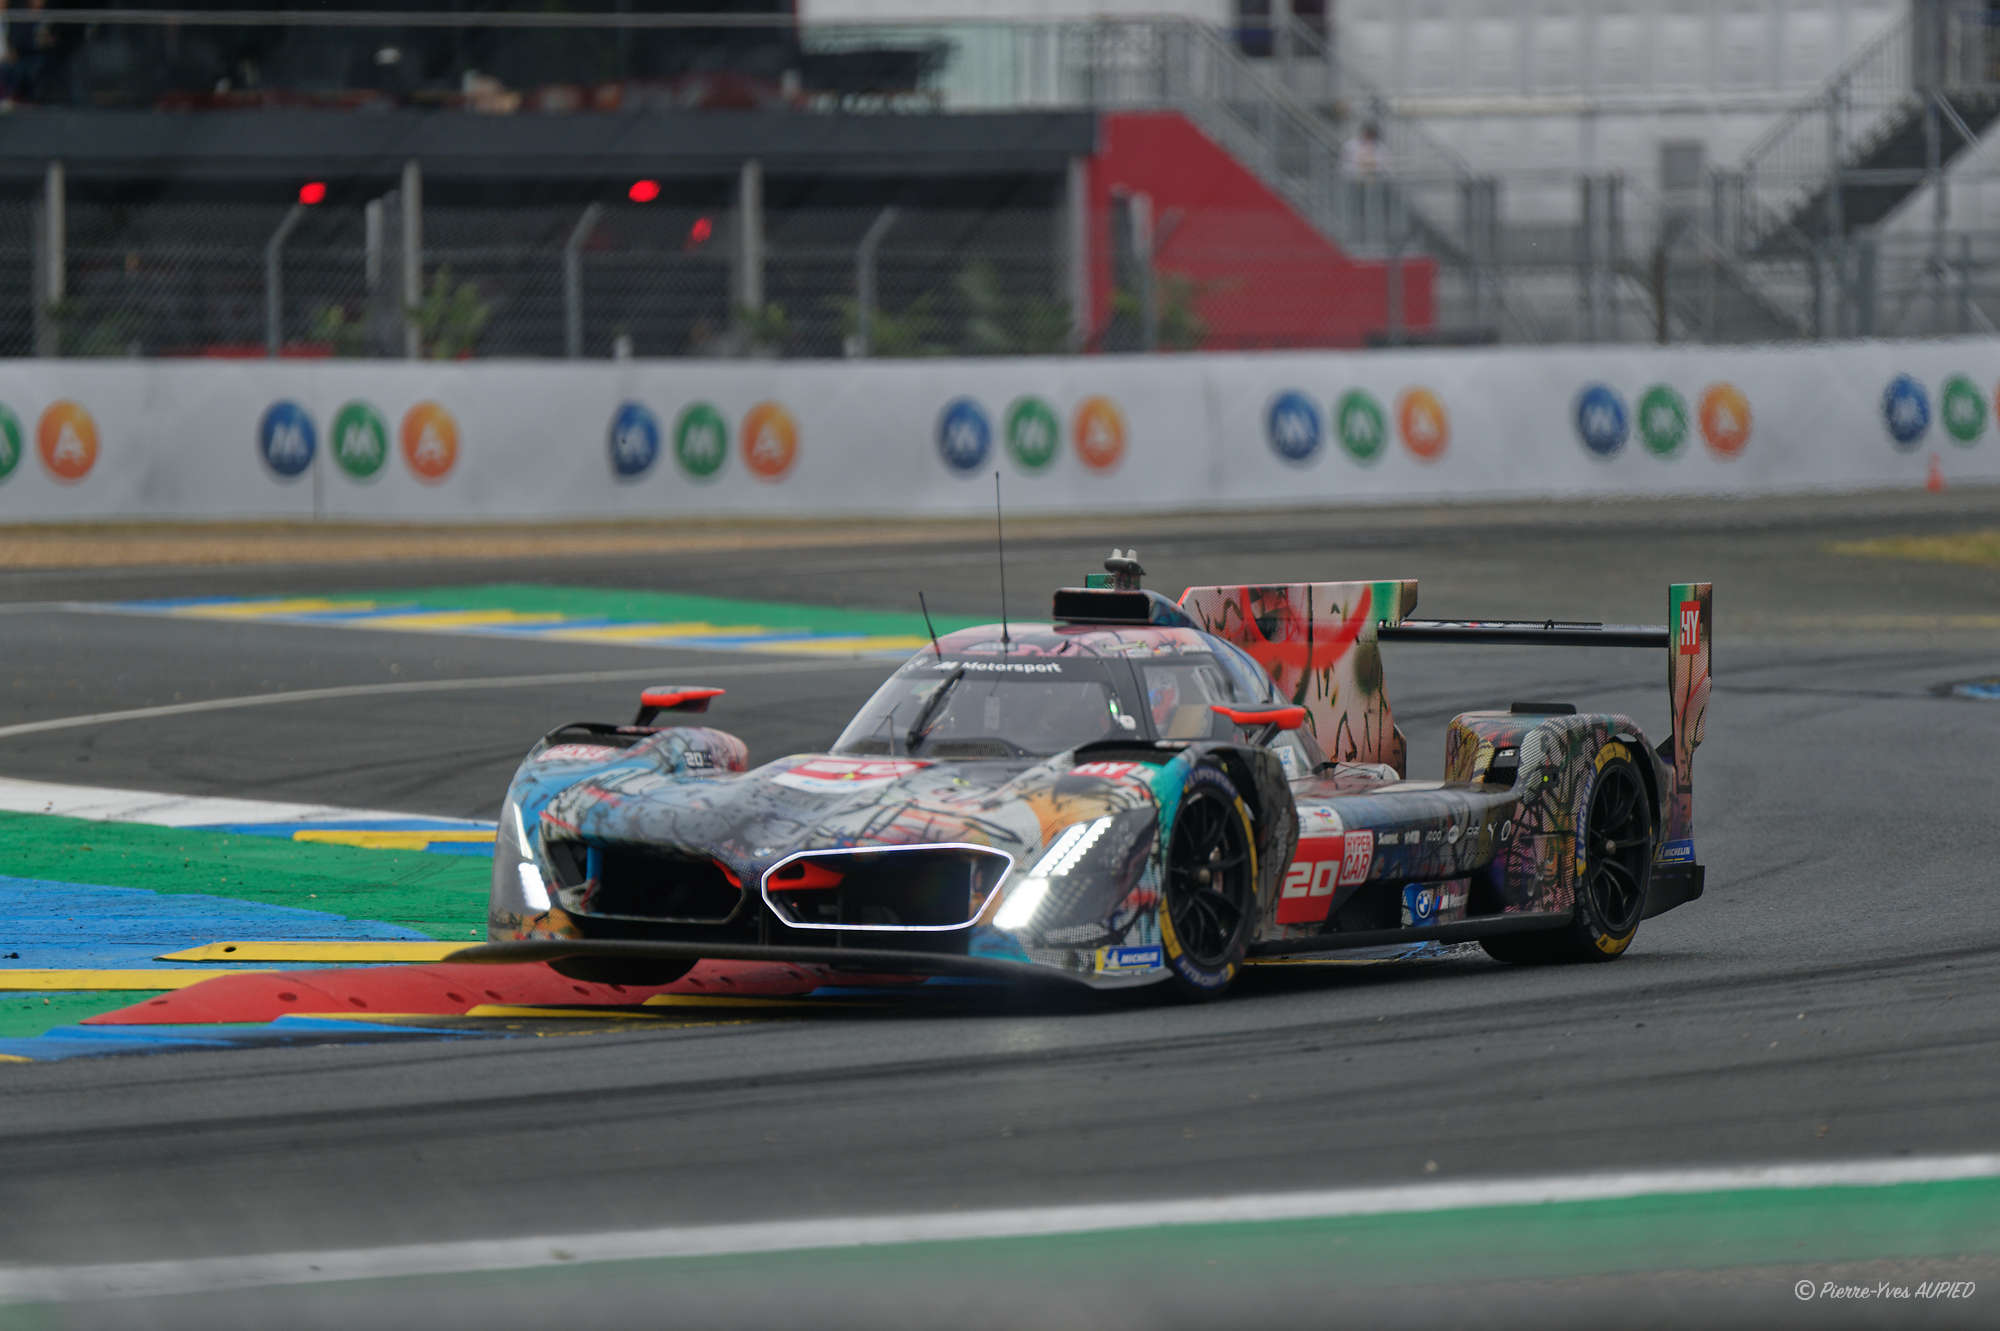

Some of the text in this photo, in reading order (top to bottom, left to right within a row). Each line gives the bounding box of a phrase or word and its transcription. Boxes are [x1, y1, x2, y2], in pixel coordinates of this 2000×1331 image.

[1681, 610, 1700, 647] HY
[962, 661, 1062, 674] Motorsport
[1282, 861, 1340, 899] 20
[1342, 854, 1370, 881] CAR
